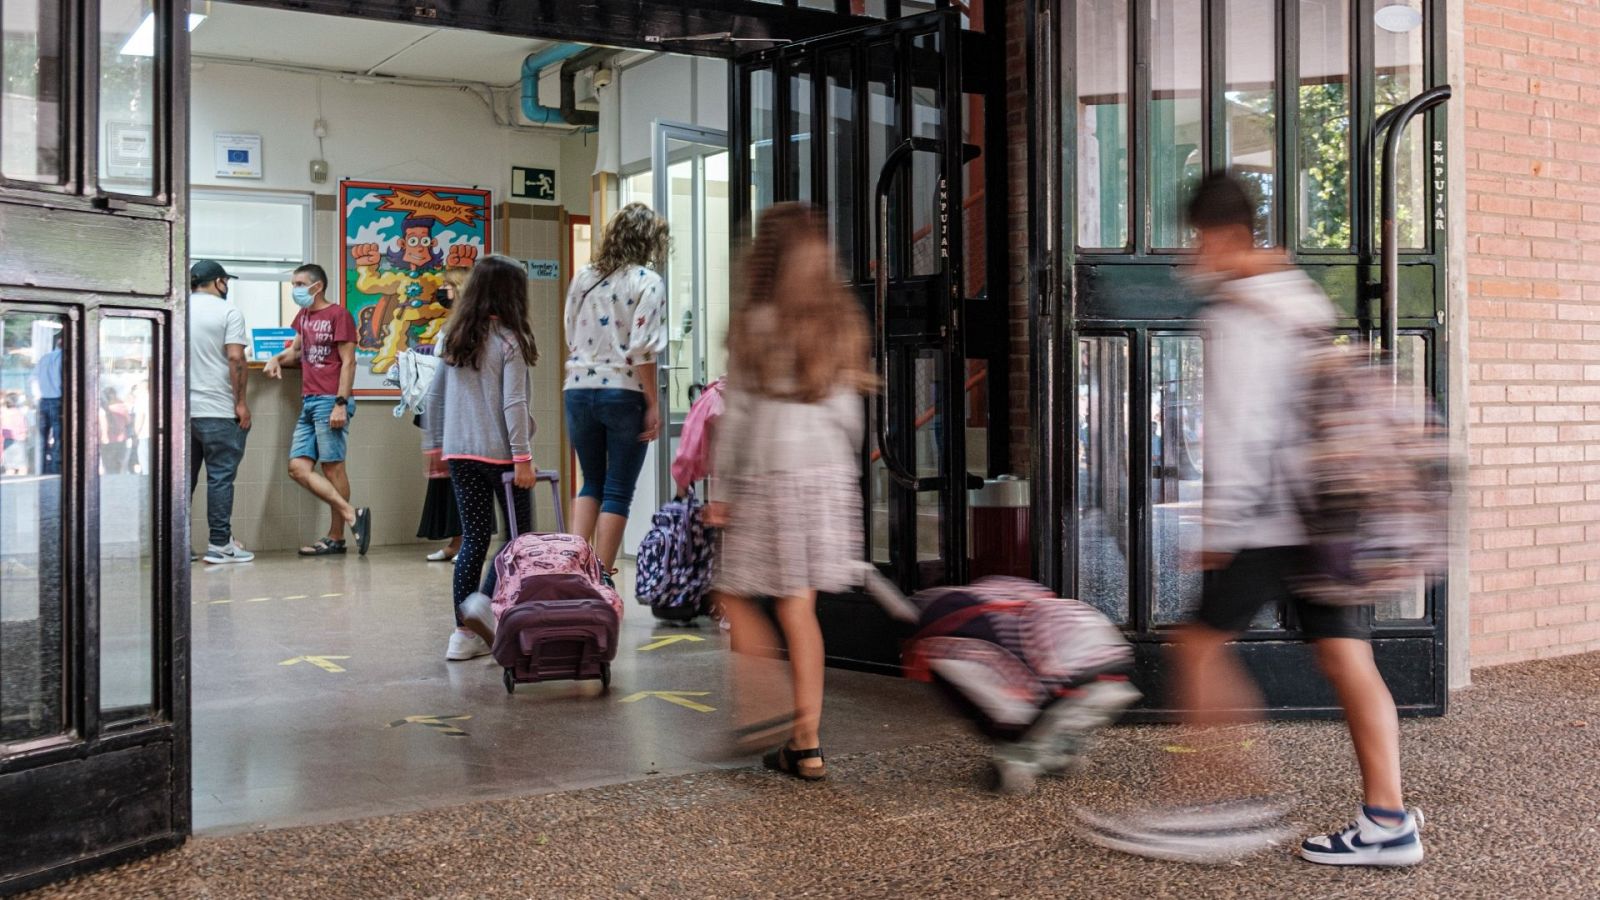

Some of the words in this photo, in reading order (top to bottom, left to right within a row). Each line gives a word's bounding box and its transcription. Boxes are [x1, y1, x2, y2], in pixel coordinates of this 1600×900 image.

[400, 197, 462, 214] SUPERCUIDADOS
[940, 180, 948, 257] EMPUJAR
[1434, 141, 1445, 229] EMPUJAR
